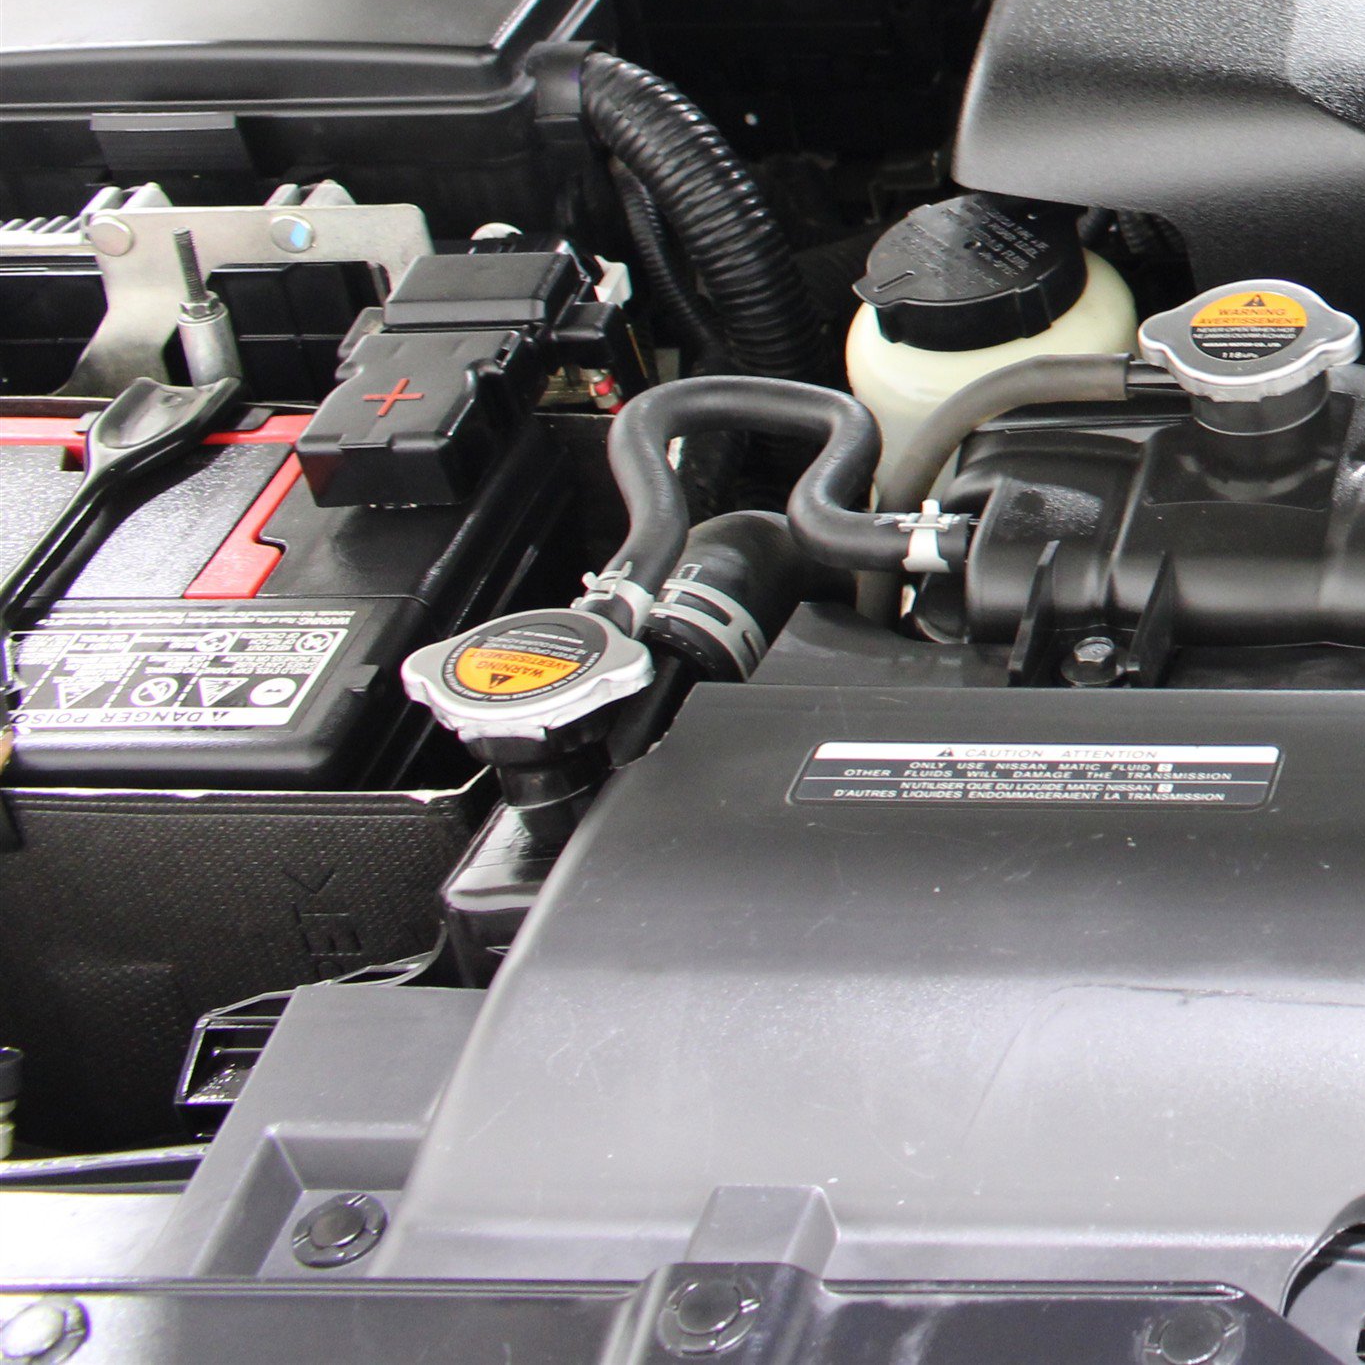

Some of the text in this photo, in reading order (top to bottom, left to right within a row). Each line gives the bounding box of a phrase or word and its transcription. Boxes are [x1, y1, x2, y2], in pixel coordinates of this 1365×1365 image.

[468, 651, 572, 670] AVERTISSEMENT
[476, 660, 545, 679] WARNING
[11, 711, 203, 725] DANGER POISO
[964, 748, 1158, 759] CAUTION ATTENTION
[909, 761, 947, 769] ONLY
[956, 761, 985, 770] USE
[994, 762, 1048, 770] NISSAN
[1057, 763, 1101, 771] MATIC
[1110, 763, 1151, 771] FLUID
[843, 769, 1232, 780] OTHER FLUIDS WILL DAMAGE THE TRANSMISSION
[966, 782, 993, 790] QUE
[996, 783, 1015, 791] DU
[1016, 783, 1065, 791] LIQUIDE
[1105, 784, 1153, 792] NISSAN
[833, 789, 1225, 801] D'AUTRES LIQUIDES ENDOMMAGERAIENT LA TRANSMISSION
